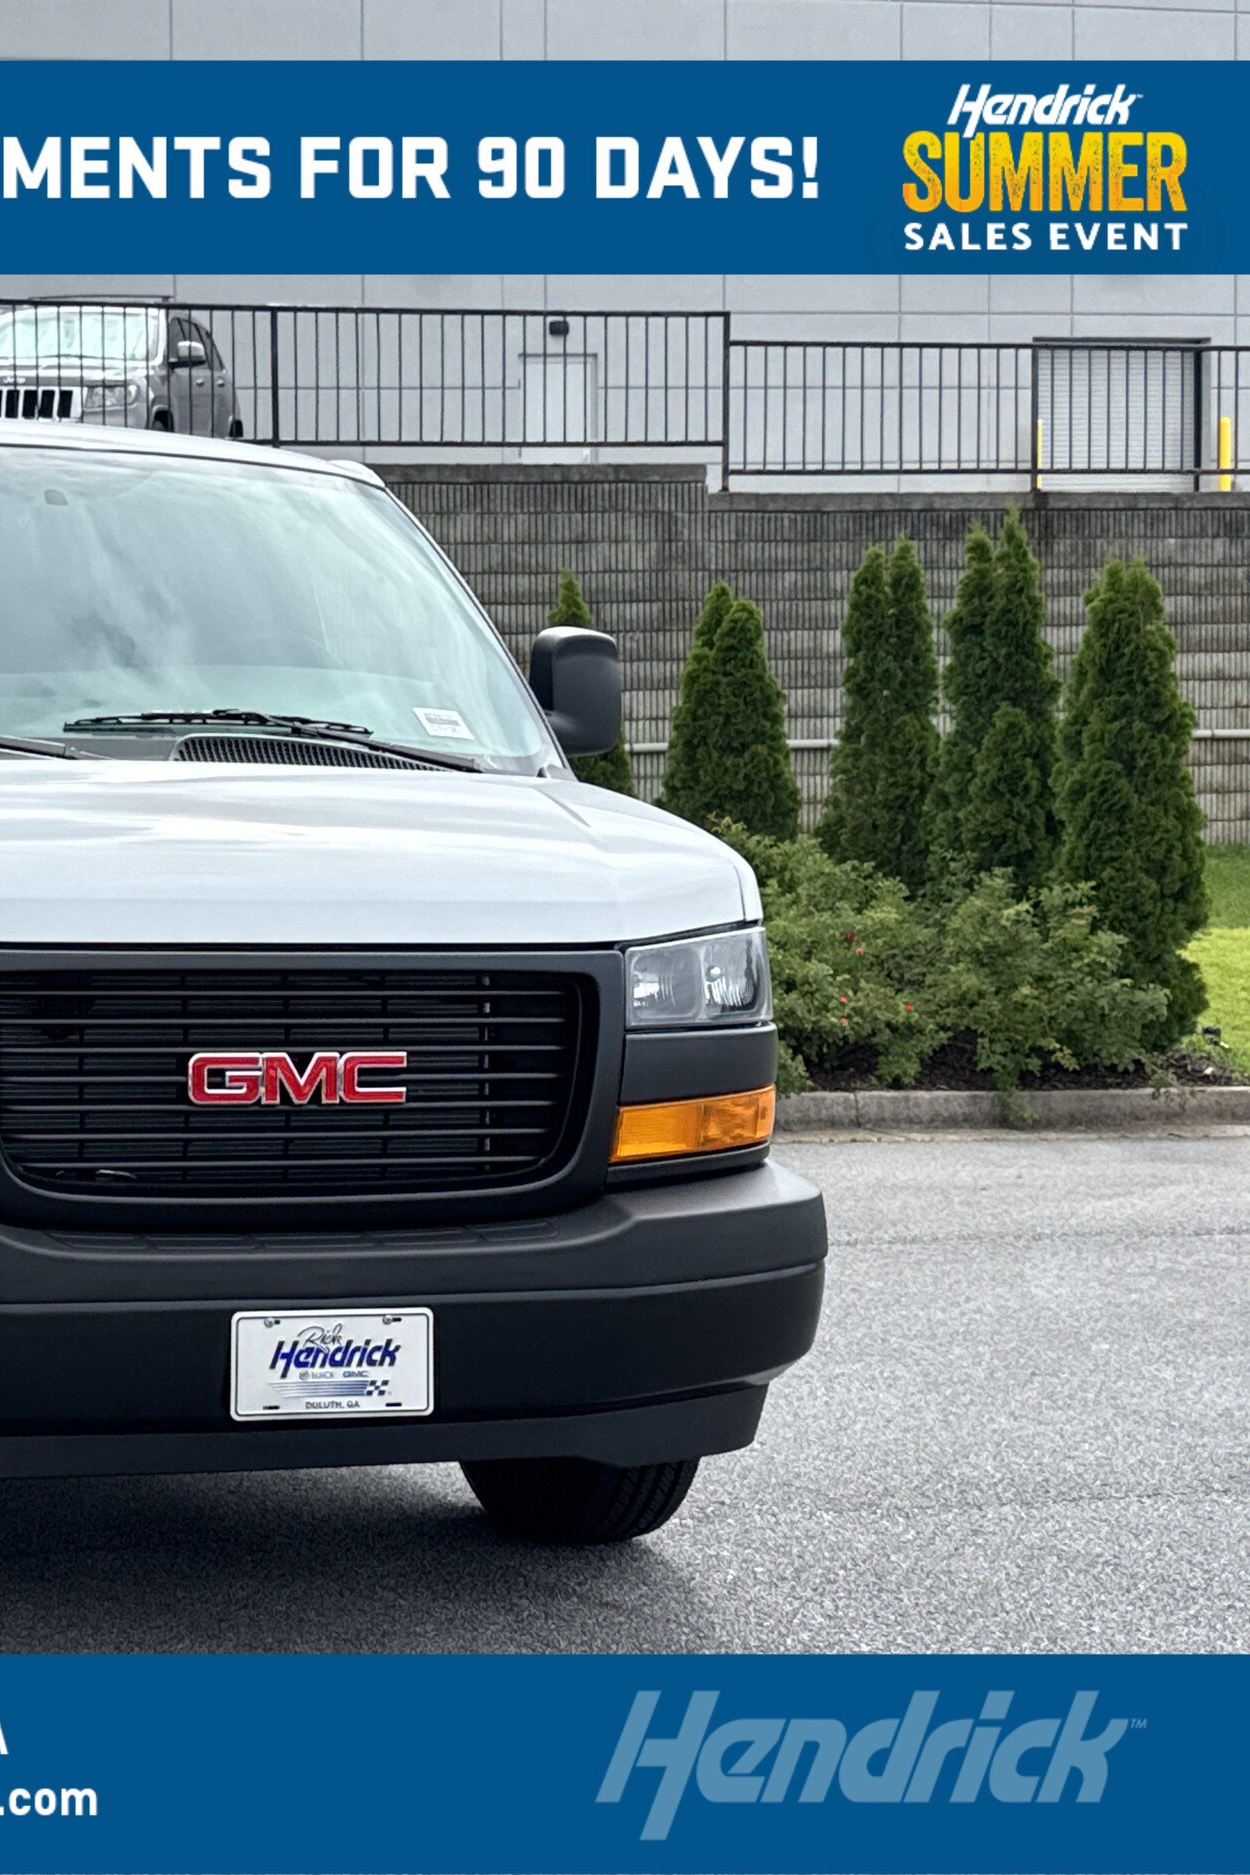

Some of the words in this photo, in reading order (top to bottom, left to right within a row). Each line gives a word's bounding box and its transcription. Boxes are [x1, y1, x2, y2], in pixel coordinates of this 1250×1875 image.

[187, 1051, 408, 1105] GMC
[269, 1338, 402, 1379] Hendrick
[297, 1323, 342, 1354] Rick
